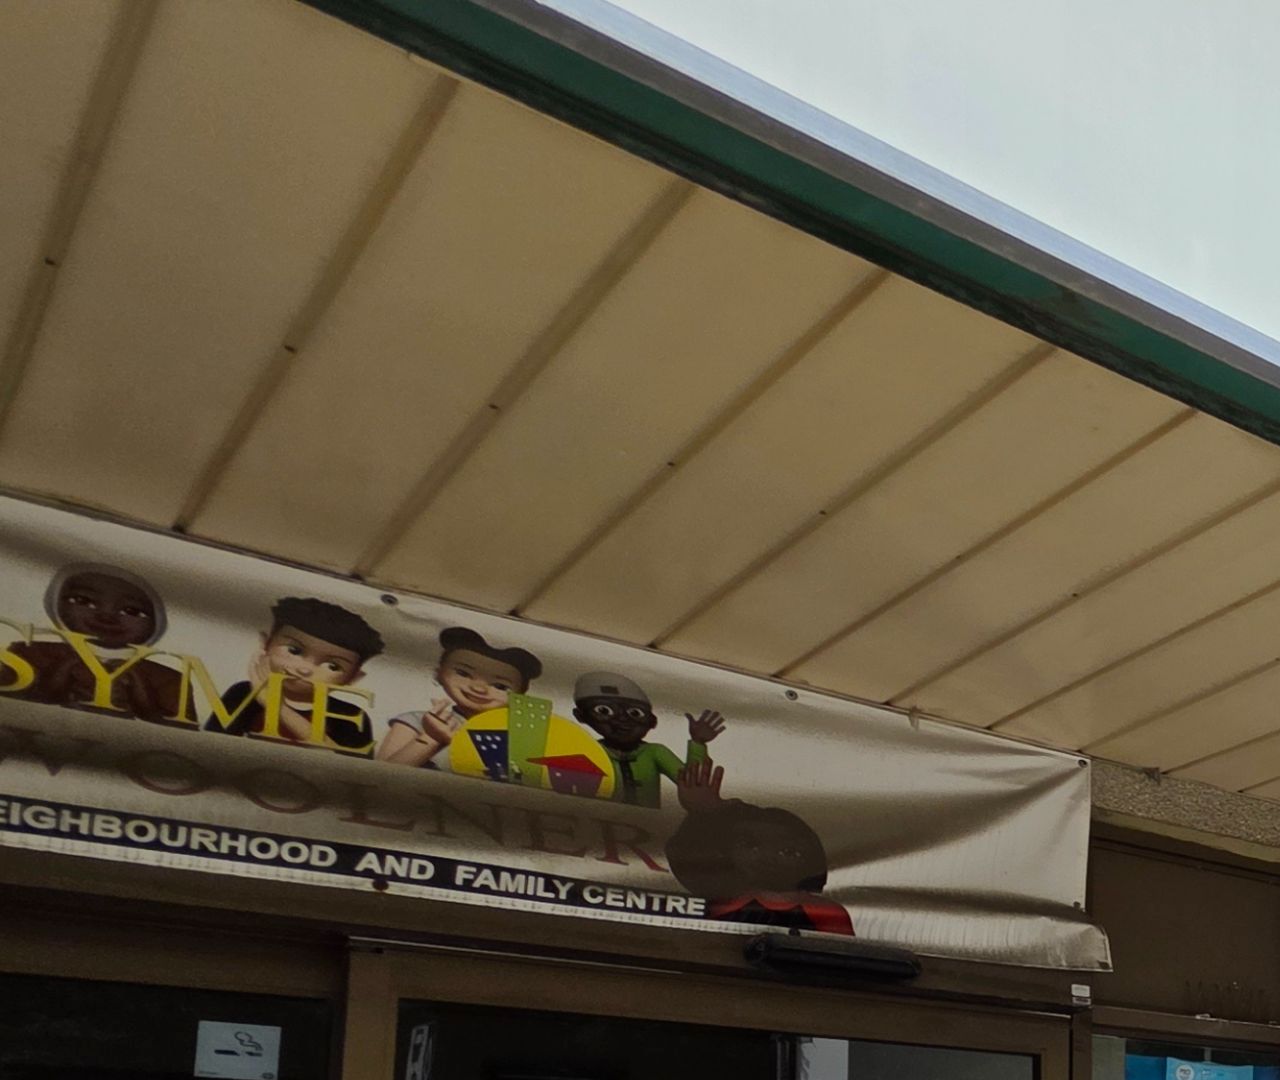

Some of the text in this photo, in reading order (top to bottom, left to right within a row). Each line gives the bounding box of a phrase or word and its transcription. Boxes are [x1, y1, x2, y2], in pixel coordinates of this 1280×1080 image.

[355, 851, 435, 881] AND
[454, 864, 575, 901] FAMILY
[582, 884, 706, 917] CENTRE
